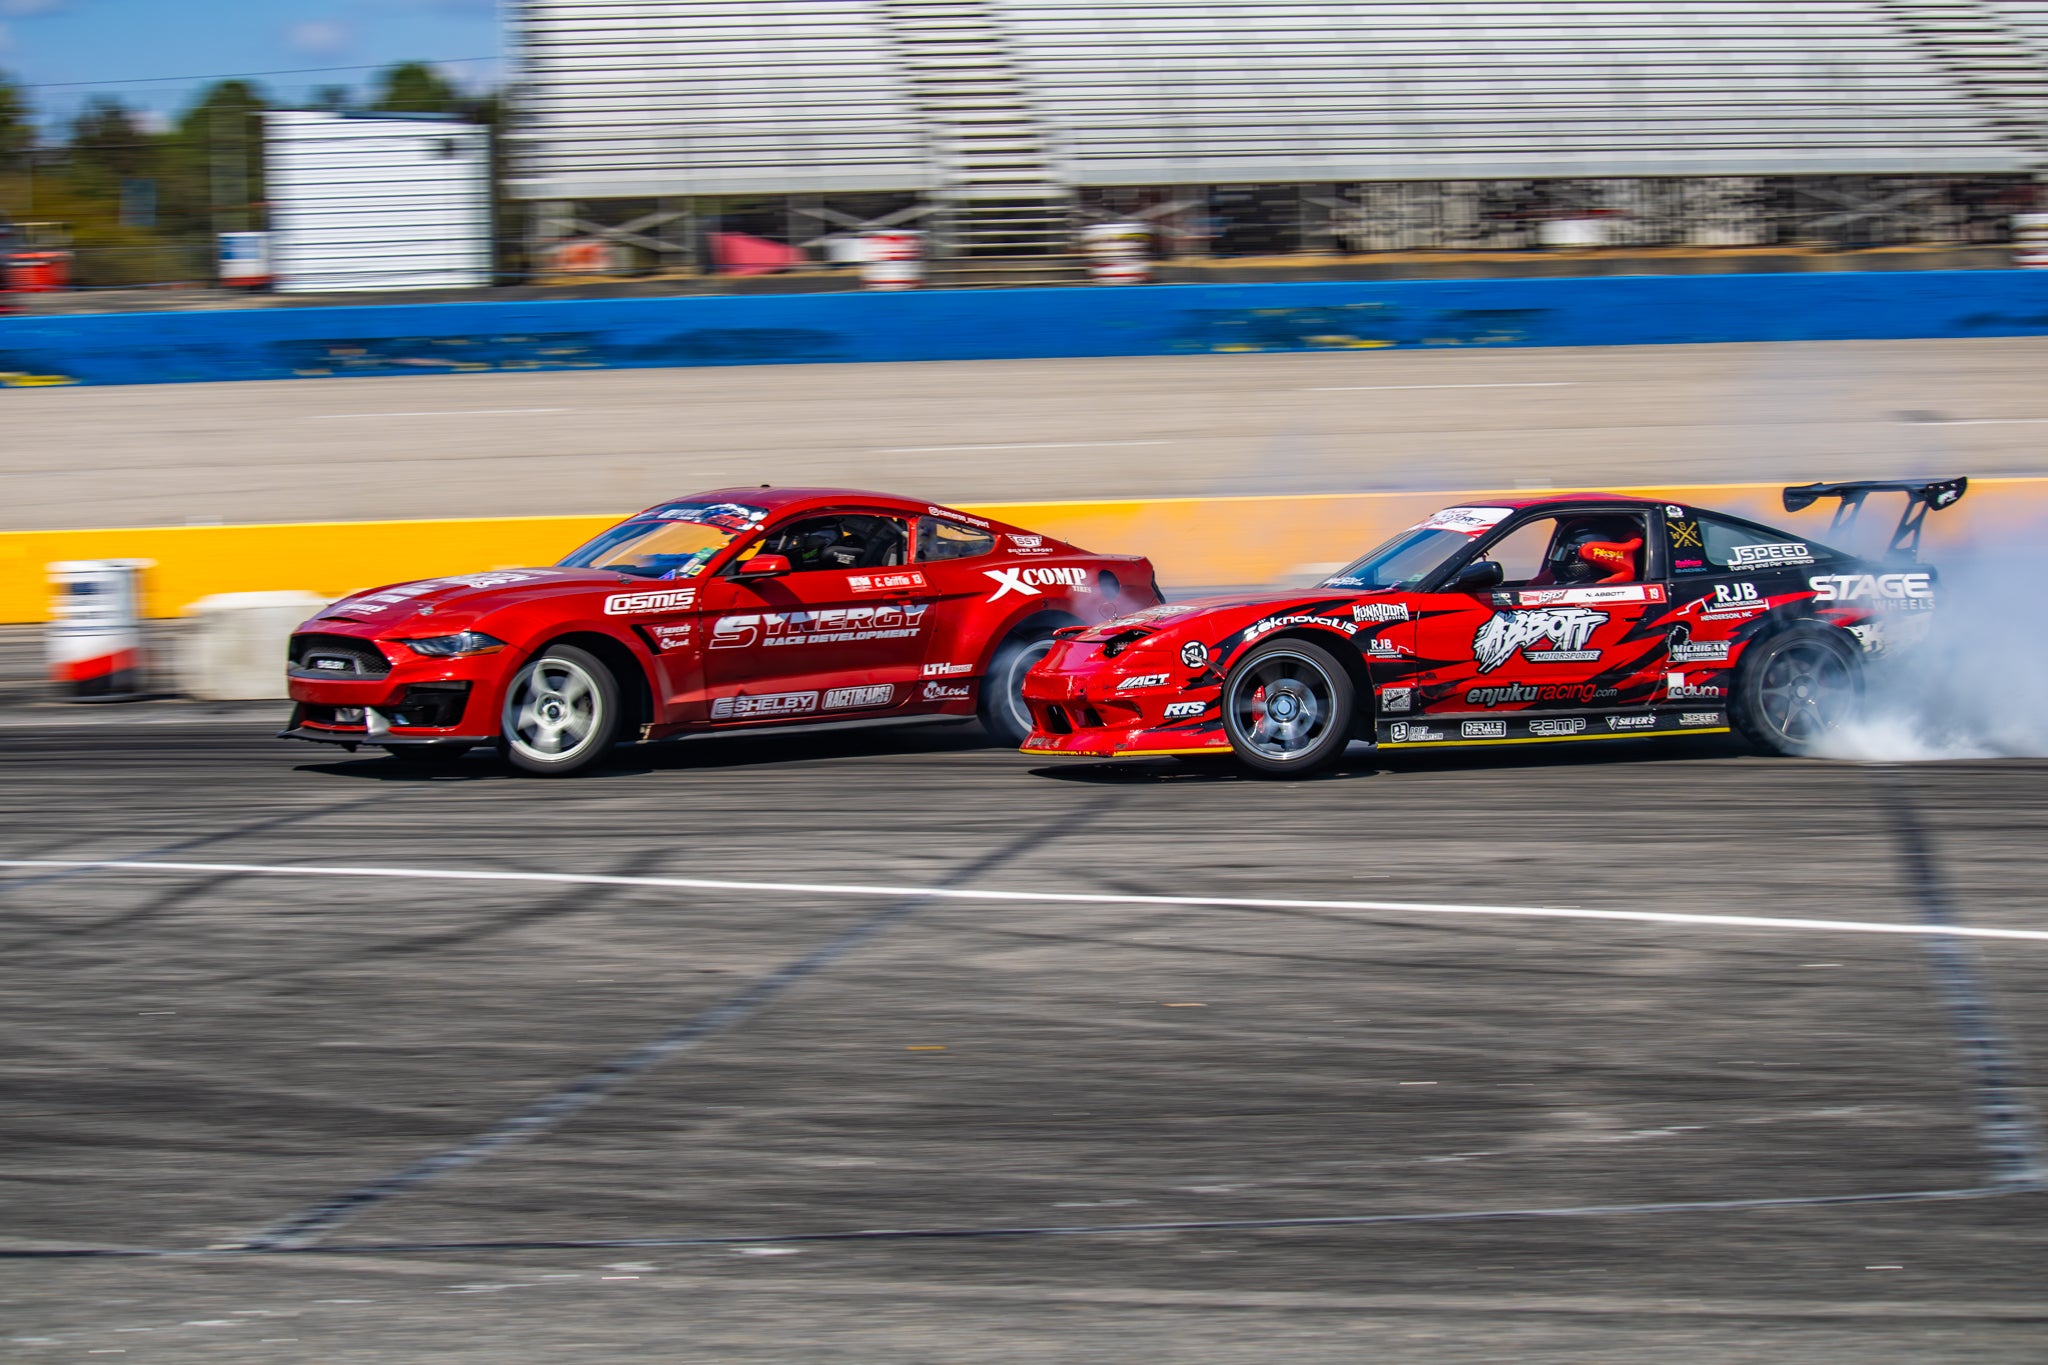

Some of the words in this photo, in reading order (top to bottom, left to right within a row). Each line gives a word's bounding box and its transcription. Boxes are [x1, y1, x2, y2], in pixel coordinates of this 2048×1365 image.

[1016, 537, 1038, 545] SST
[1727, 546, 1809, 565] JSPEED
[1729, 564, 1755, 572] Tuning
[1072, 585, 1092, 593] TIRES
[1595, 590, 1626, 598] ABBOTT
[1649, 588, 1659, 599] 19
[1714, 582, 1758, 602] RJB
[1809, 573, 1934, 603] STAGE
[604, 588, 696, 615] COSMIS
[1873, 599, 1935, 610] WHEELS
[708, 604, 929, 649] SYNERGY
[762, 634, 806, 646] RACE
[807, 628, 920, 643] DEVELOPMENT
[1370, 639, 1392, 649] RJB
[1473, 607, 1609, 674] ABBOTT
[1672, 643, 1727, 653] MICHIGAN
[1535, 651, 1597, 660] MOTORSPORTS
[923, 662, 951, 675] LTH
[1128, 673, 1170, 687] ACT
[1467, 682, 1618, 708] enjukuracing.com
[1669, 682, 1720, 696] radium
[733, 695, 812, 712] SHELBY
[825, 685, 886, 708] RACETREADS
[1164, 701, 1207, 716] RTS
[1618, 714, 1656, 725] SILVER'S
[1466, 722, 1502, 732] DERALE
